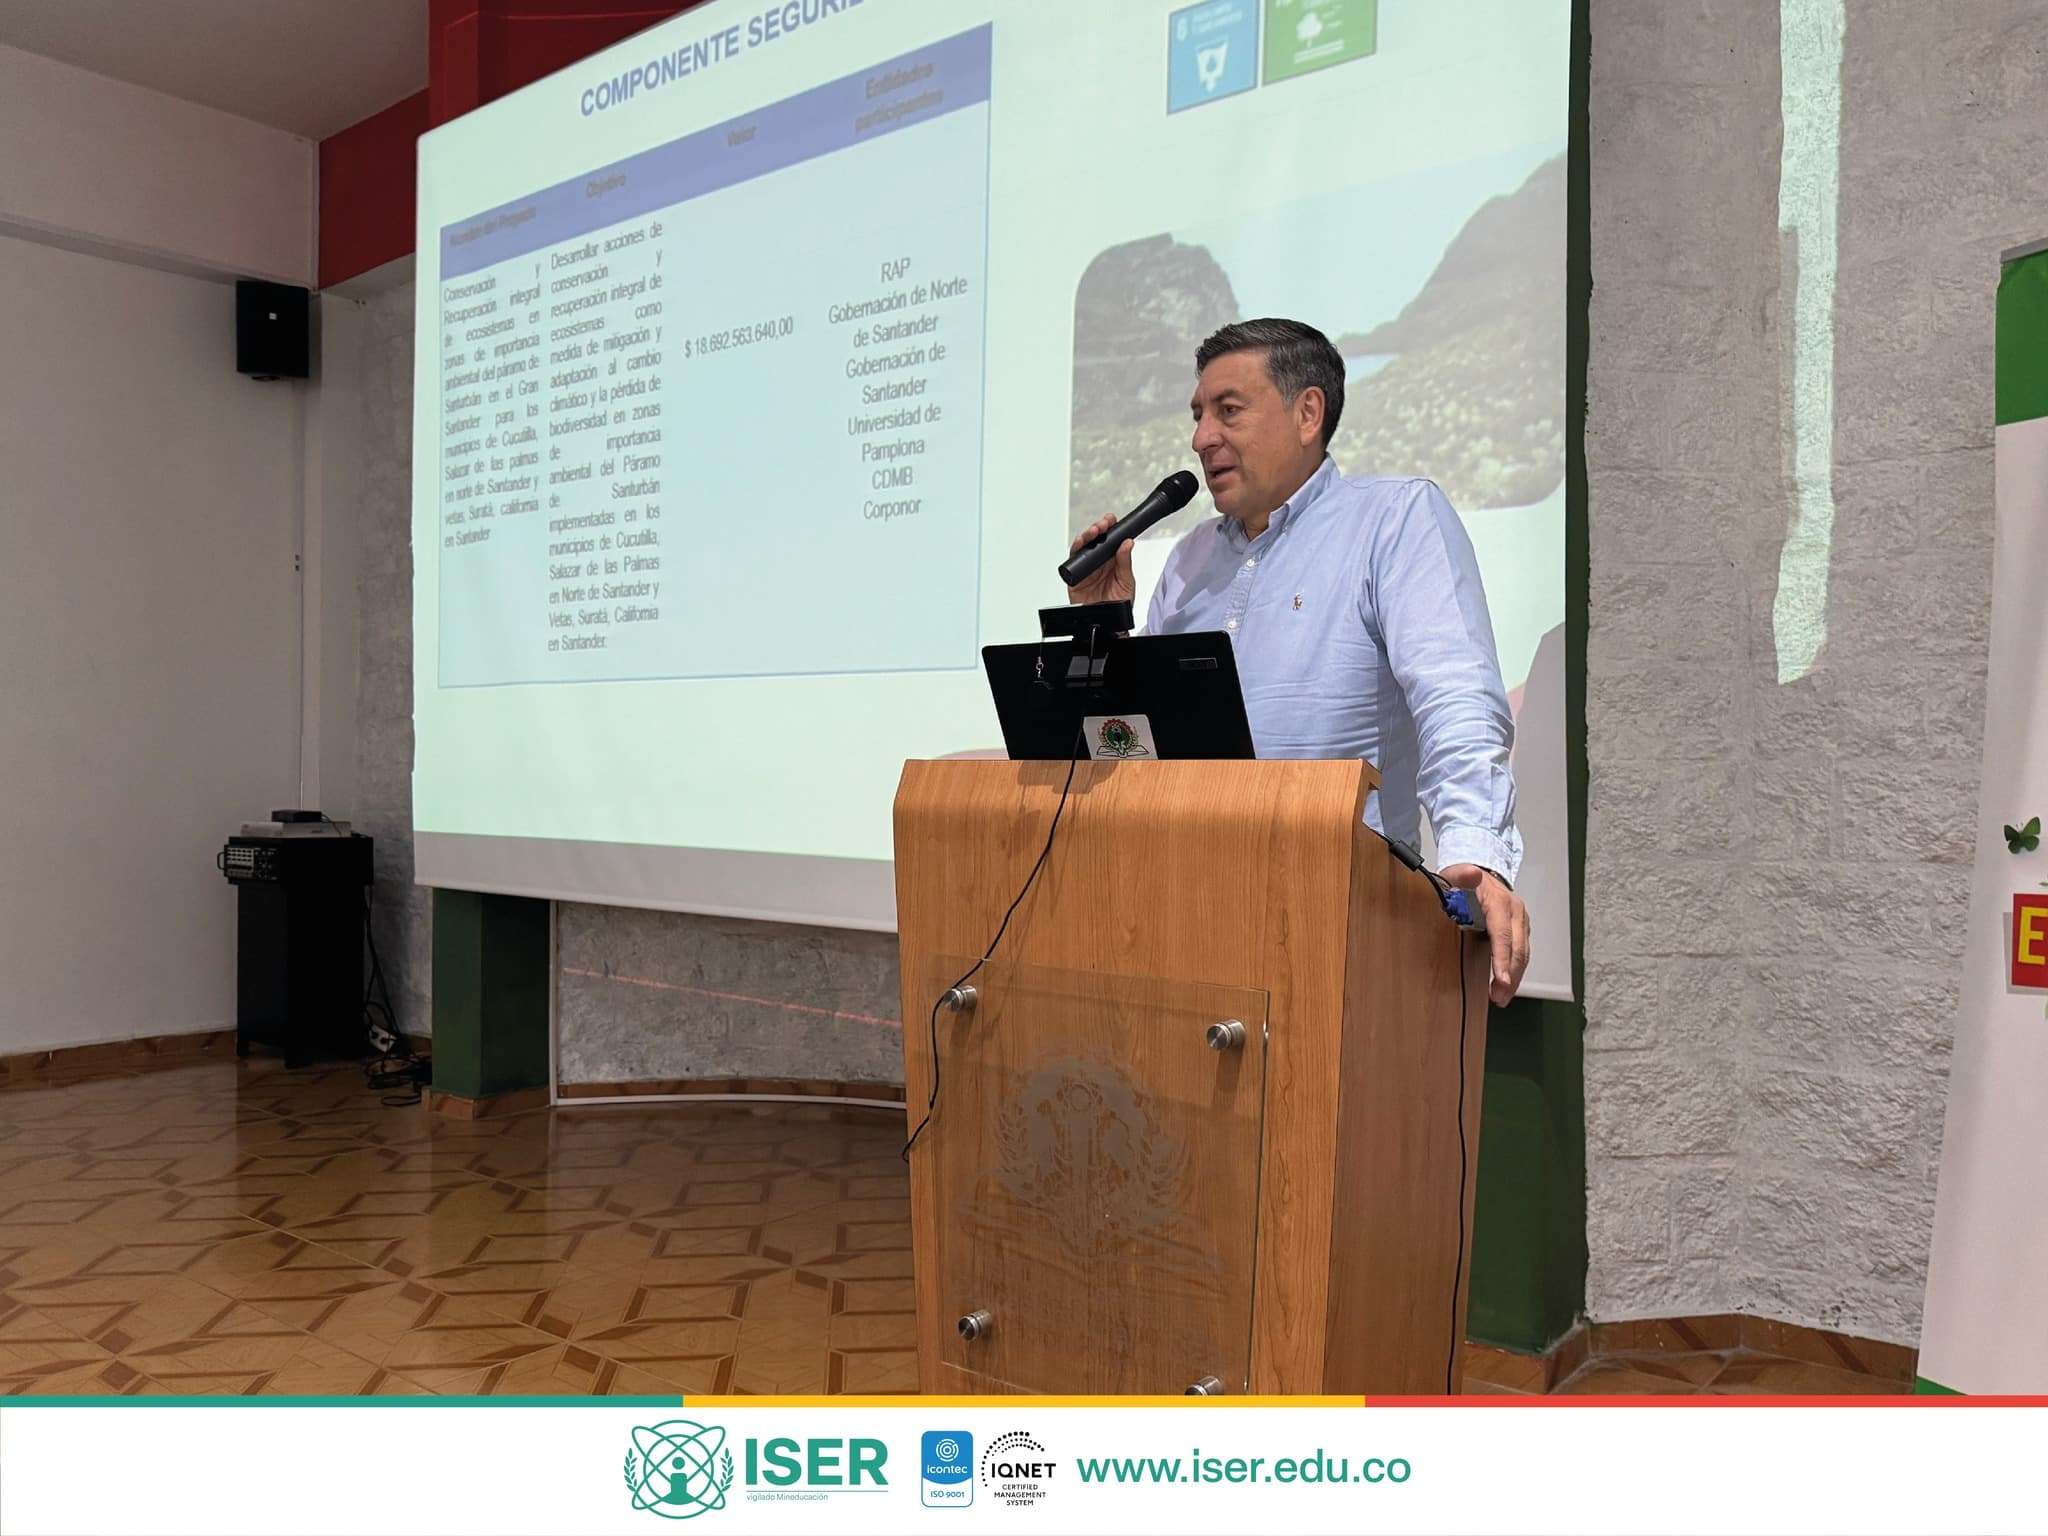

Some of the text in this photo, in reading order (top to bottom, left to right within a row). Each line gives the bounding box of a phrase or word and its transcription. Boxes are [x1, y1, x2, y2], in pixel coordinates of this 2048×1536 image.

[580, 24, 740, 117] COMPONENTE
[604, 229, 645, 253] acciones
[649, 220, 663, 239] de
[656, 248, 663, 268] y
[881, 256, 911, 283] RAP
[611, 275, 646, 301] integral
[649, 273, 663, 290] de
[828, 275, 969, 324] Gobernación de Norte
[635, 301, 663, 320] como
[853, 313, 939, 348] de Santander
[550, 342, 582, 365] medida
[586, 338, 599, 356] de
[655, 325, 663, 344] y
[684, 338, 692, 359] $
[608, 357, 617, 376] al
[627, 350, 662, 372] cambio
[845, 340, 946, 379] Gobernación de
[591, 391, 598, 408] y
[599, 386, 608, 403] la
[649, 374, 662, 392] de
[862, 376, 927, 405] Santander
[613, 410, 626, 424] en
[632, 402, 661, 421] zonas
[847, 402, 942, 436] Universidad de
[861, 438, 926, 463] Pamplona
[549, 460, 592, 485] ambiental
[600, 457, 615, 477] del
[872, 465, 914, 490] CDMB
[624, 508, 637, 522] en
[646, 503, 660, 521] los
[863, 498, 922, 522] Corponor
[599, 533, 612, 551] de
[586, 560, 599, 577] de
[604, 557, 618, 575] las
[623, 554, 660, 573] Palmas
[549, 579, 660, 604] en Norte de Santander y
[548, 638, 560, 652] en
